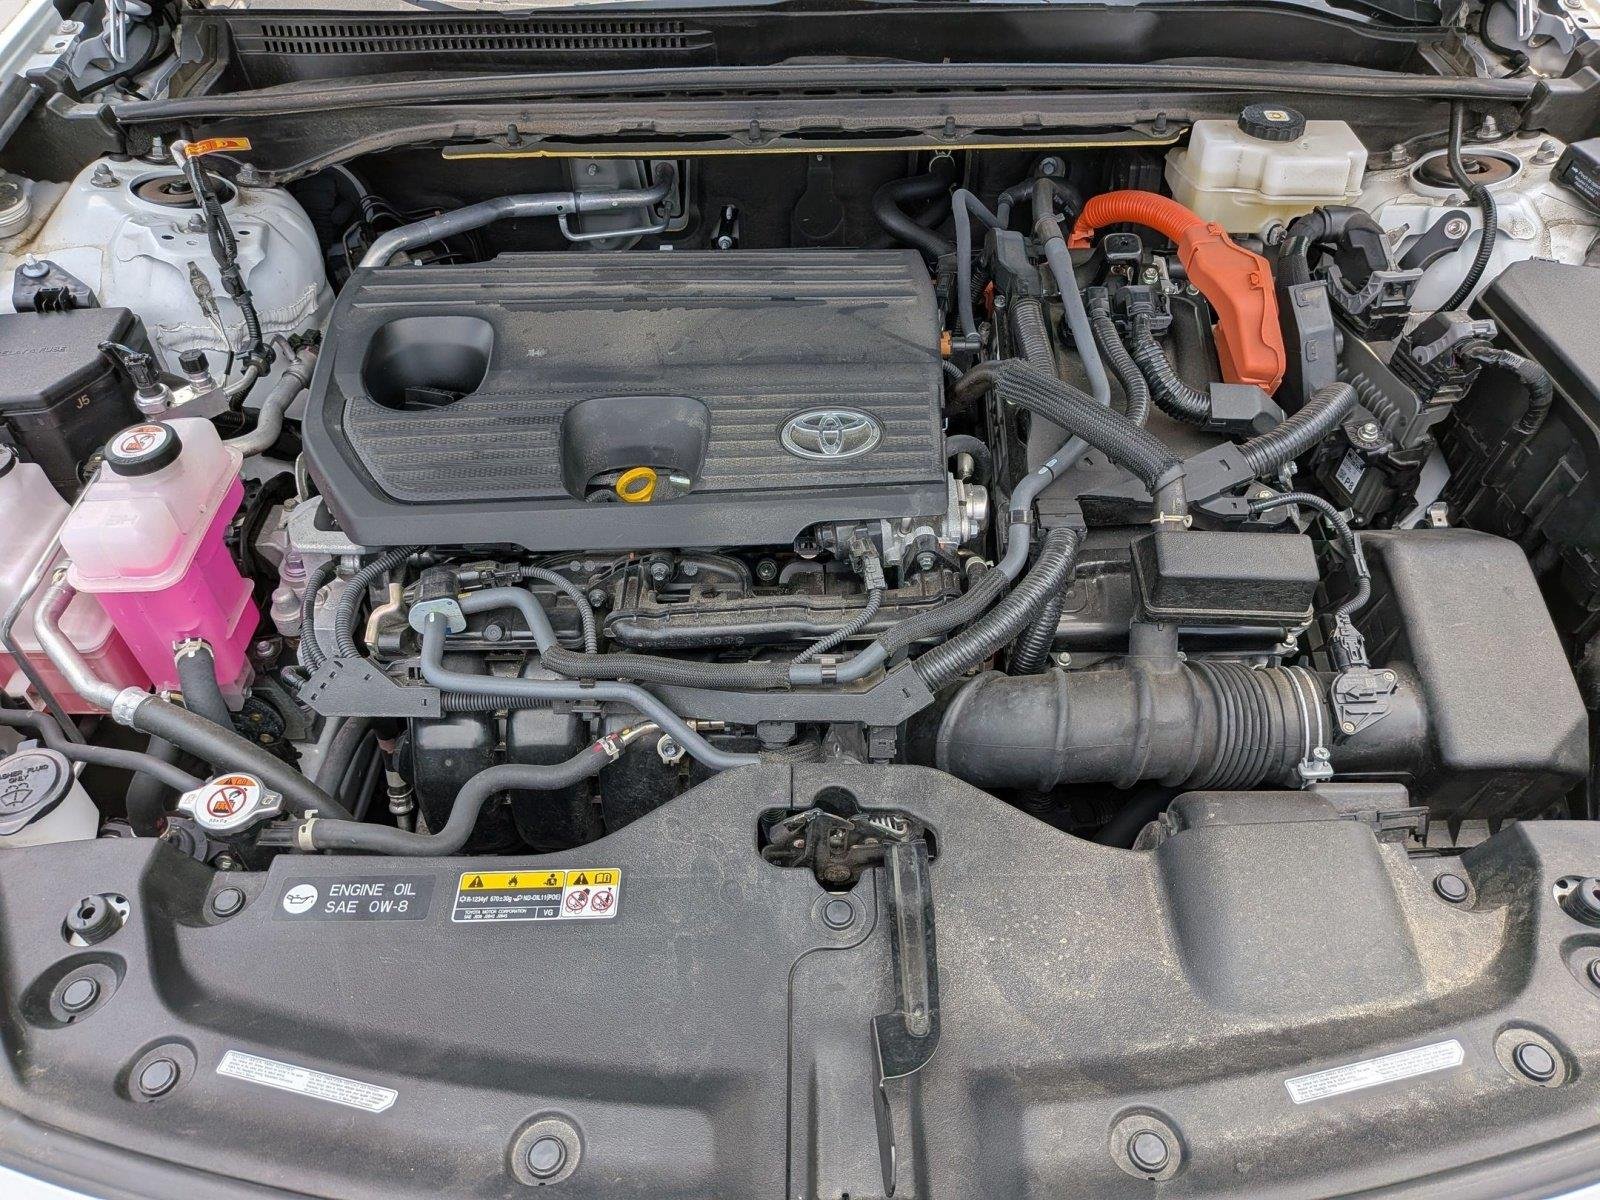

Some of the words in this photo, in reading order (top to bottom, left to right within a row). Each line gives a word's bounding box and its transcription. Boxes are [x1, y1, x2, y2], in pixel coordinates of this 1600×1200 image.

[76, 394, 90, 409] J5
[27, 764, 49, 773] FLUID
[9, 774, 29, 783] ONLY
[329, 883, 385, 897] ENGINE
[393, 883, 416, 896] OIL
[324, 900, 359, 914] SAE
